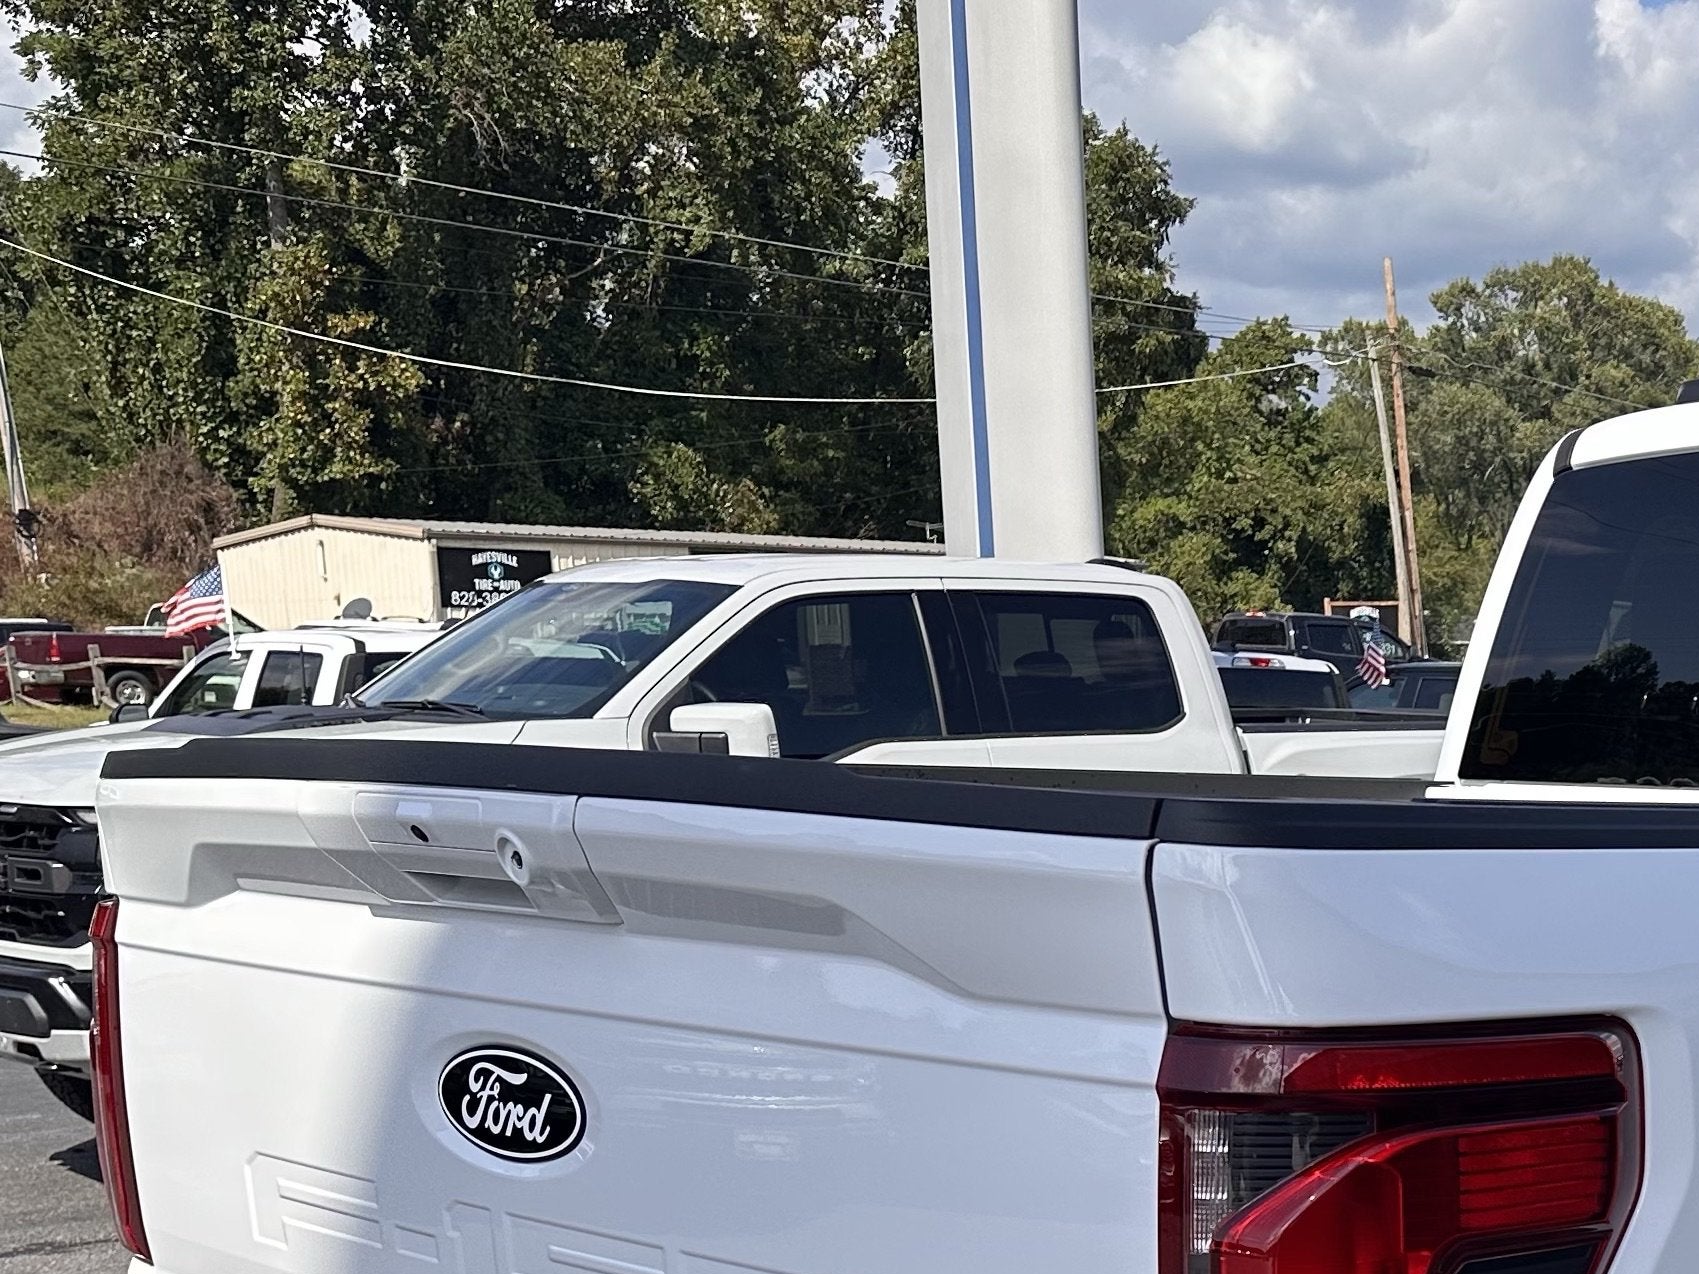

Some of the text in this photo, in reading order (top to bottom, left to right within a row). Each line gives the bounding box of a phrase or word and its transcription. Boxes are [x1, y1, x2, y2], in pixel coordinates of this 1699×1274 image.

[471, 551, 519, 568] HAYESVILLE
[473, 578, 494, 591] TIRE
[499, 579, 521, 591] AUTO
[461, 1061, 553, 1145] Ford
